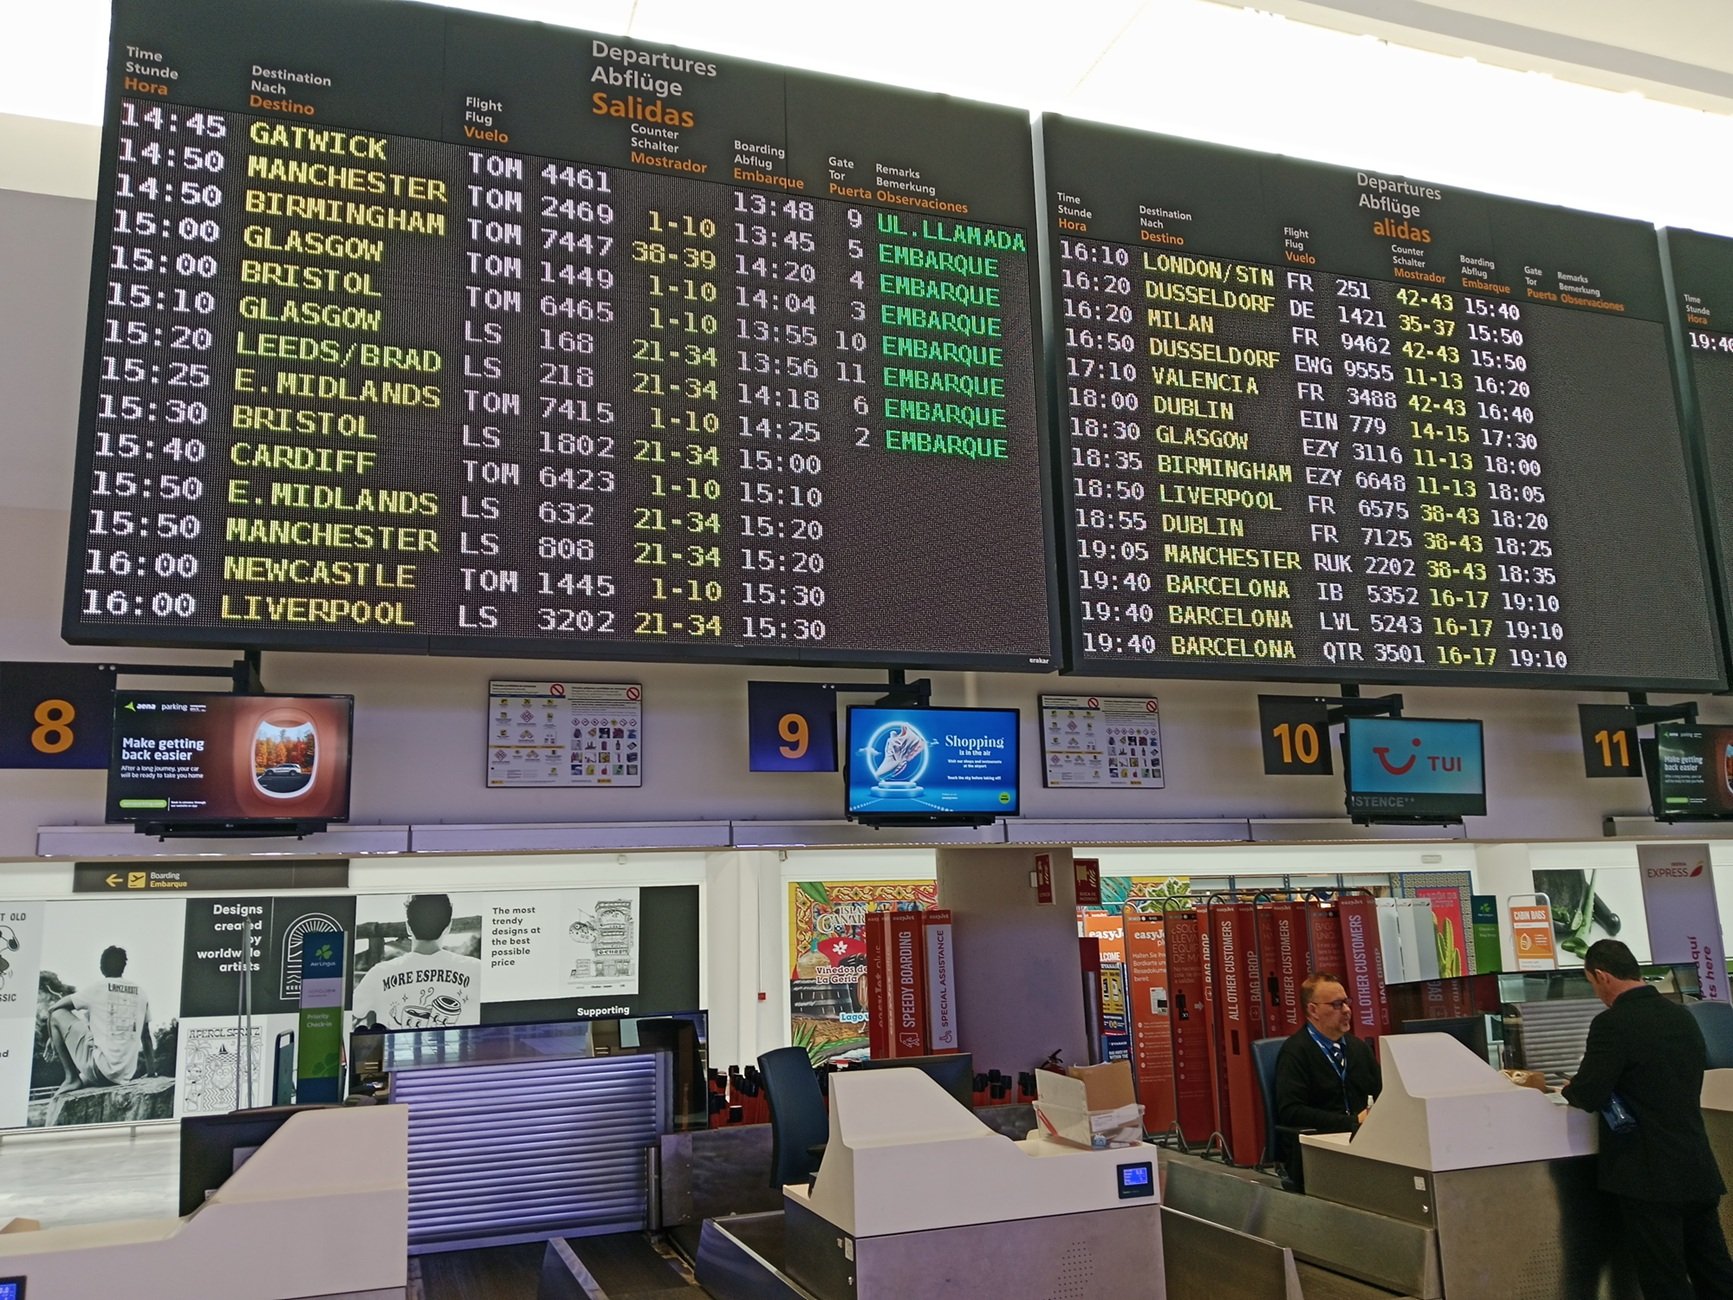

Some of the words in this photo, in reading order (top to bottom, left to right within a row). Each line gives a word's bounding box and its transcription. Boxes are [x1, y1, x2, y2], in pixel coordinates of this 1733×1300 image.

[127, 46, 162, 62] Time
[592, 40, 716, 77] Departures
[126, 62, 178, 80] Stunde
[252, 66, 331, 87] Destination
[125, 77, 168, 96] Hora
[251, 80, 286, 95] Nach
[591, 66, 682, 96] Abflüge
[250, 95, 314, 116] Destino
[466, 97, 502, 112] Flight
[592, 92, 694, 128] Salidas
[466, 112, 492, 126] Flug
[464, 126, 508, 143] Vuelo
[631, 124, 679, 140] Counter
[631, 137, 679, 154] Schalter
[734, 140, 785, 158] Boarding
[631, 152, 706, 173] Mostrador
[734, 154, 772, 170] Abflug
[828, 156, 854, 170] Gate
[121, 103, 226, 138] 14:45
[250, 122, 386, 160] GATWICK
[468, 152, 522, 180] TOM
[541, 164, 611, 193] 4461
[734, 191, 814, 222] 13:48
[847, 208, 862, 229] 9
[878, 213, 1027, 252] UL.LLAMADA
[734, 168, 804, 190] Embarque
[828, 169, 846, 181] Tor
[876, 164, 920, 179] Remarks
[829, 183, 872, 200] Puerta
[876, 176, 936, 196] Bemerkung
[1357, 172, 1442, 202] Departures
[876, 191, 968, 214] Observaciones
[1358, 194, 1420, 218] Abflüge
[1374, 218, 1432, 244] alidas
[116, 174, 222, 207] 14:50
[246, 190, 446, 236] BIRMINGHAM
[468, 218, 522, 246] TOM
[541, 228, 613, 257] 7447
[632, 240, 716, 270] 38-39
[735, 254, 816, 284] 14:20
[850, 270, 864, 290] 4
[880, 274, 1001, 308] EMBARQUE
[1060, 240, 1128, 268] 16:10
[1142, 252, 1274, 288] LONDON/STN
[1286, 272, 1314, 294] FR
[1336, 280, 1370, 302] 251
[1396, 288, 1454, 313] 42-43
[1465, 297, 1522, 322] 15:40
[1074, 477, 1144, 502] 18:50
[1160, 486, 1282, 512] LIVERPOOL
[1308, 496, 1336, 515] FR
[1358, 500, 1410, 520] 6575
[1420, 505, 1480, 526] 38-43
[1492, 510, 1549, 530] 18:20
[82, 588, 196, 618] 16:00
[221, 595, 414, 626] LIVERPOOL
[459, 604, 498, 629] LS
[538, 606, 615, 634] 3202
[634, 612, 722, 636] 21-34
[742, 616, 826, 640] 15:30
[162, 704, 188, 712] parking
[31, 699, 76, 754] 8
[778, 713, 809, 758] 9
[122, 737, 156, 748] Make
[158, 738, 205, 751] getting
[945, 734, 1004, 750] Shopping
[1273, 722, 1320, 764] 10
[1594, 730, 1630, 767] 11
[122, 749, 151, 760] back
[154, 750, 192, 760] easier
[1427, 756, 1462, 772] TUI
[150, 872, 180, 880] Boarding
[1647, 868, 1689, 878] EXPRESS
[150, 880, 187, 888] Embarque
[213, 904, 263, 917] Designs
[492, 907, 510, 915] The
[492, 918, 523, 926] trendy
[492, 927, 528, 936] designs
[492, 938, 507, 946] the
[1222, 920, 1234, 973] CUSTOMERS
[1279, 920, 1292, 974] CUSTOMERS
[1349, 914, 1367, 973] CUSTOMERS
[197, 948, 261, 959] worldwe
[491, 948, 531, 958] possible
[899, 931, 914, 984] BOARDING
[936, 930, 947, 986] ASSISTANCE
[491, 958, 516, 968] price
[1704, 946, 1714, 980] here
[382, 970, 414, 992] MORE
[416, 969, 470, 988] ESPRESSO
[816, 976, 828, 984] La
[1226, 975, 1238, 1004] OTHER
[1250, 983, 1260, 1002] BAG
[1284, 976, 1296, 1007] OTHER
[1356, 975, 1372, 1006] OTHER
[577, 1006, 630, 1017] Supporting
[902, 987, 916, 1028] SPEEDY
[940, 987, 949, 1027] SPECIAL
[1228, 1004, 1240, 1020] ALL
[1286, 1007, 1297, 1024] ALL
[841, 1013, 864, 1022] Lago
[1361, 1007, 1374, 1026] ALL
[226, 1027, 260, 1036] SPRTZ
